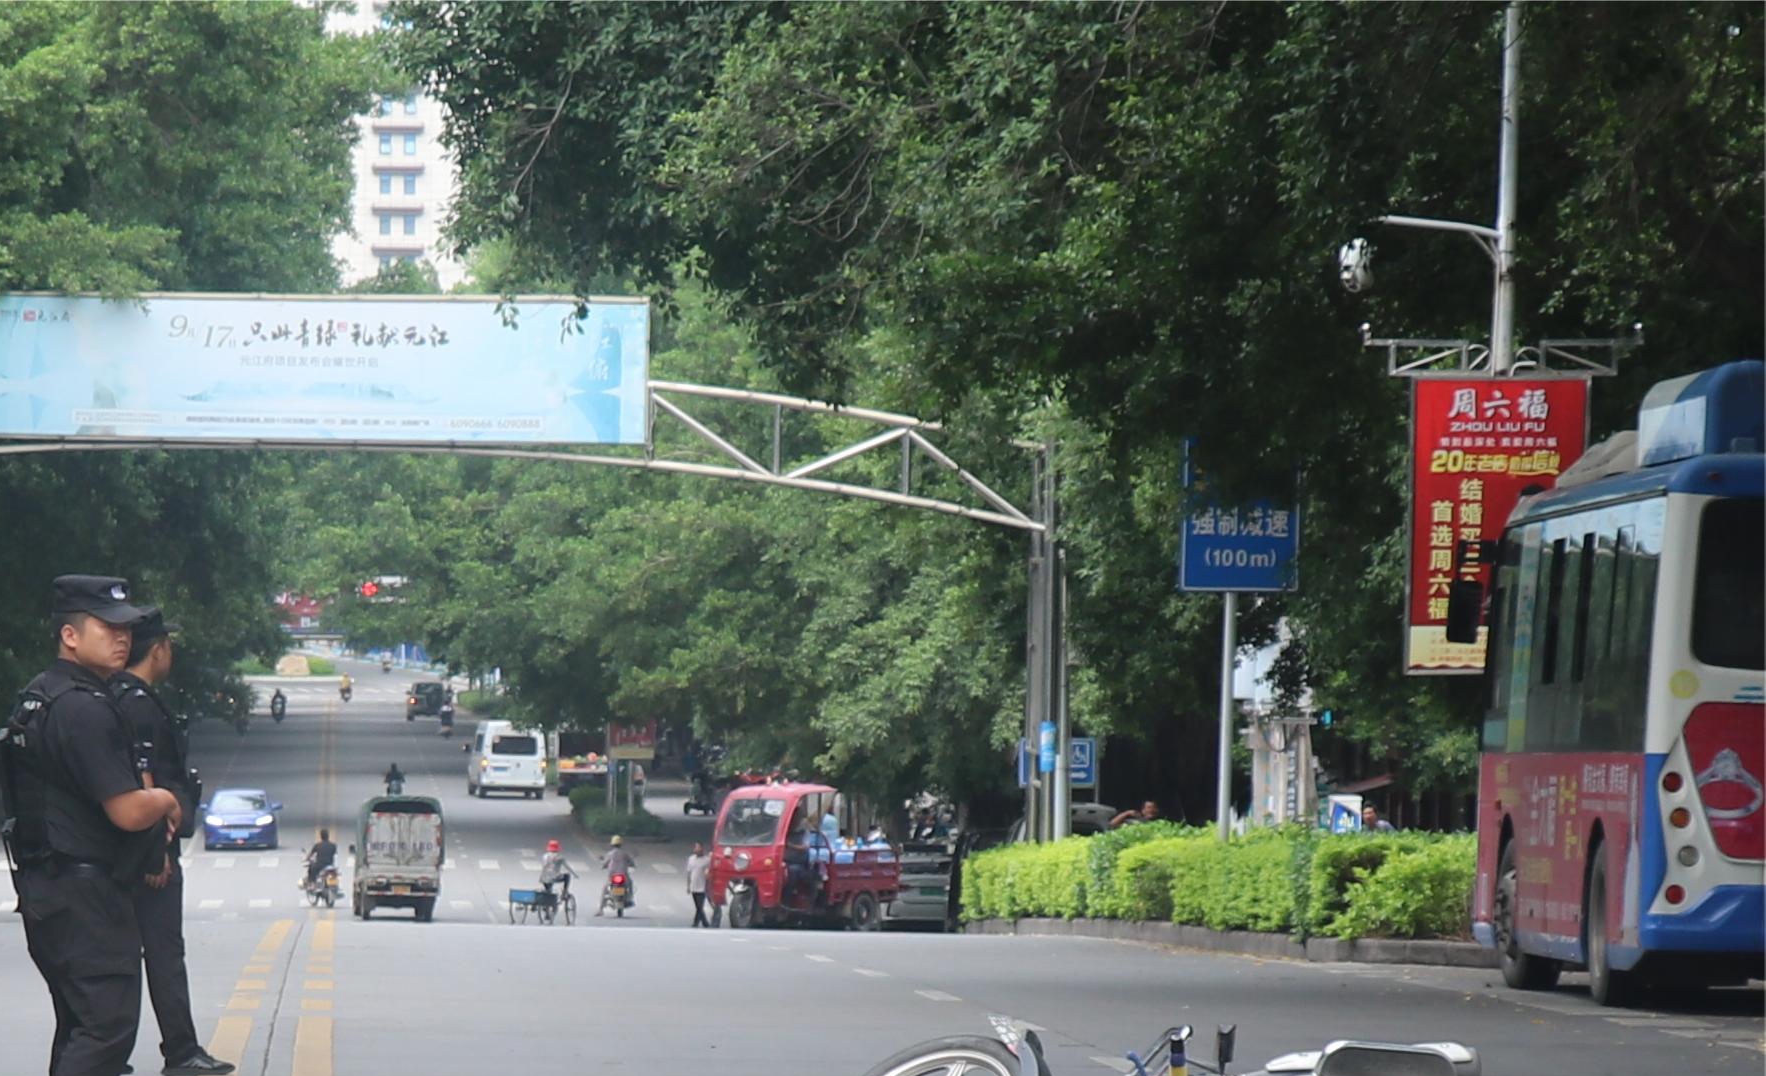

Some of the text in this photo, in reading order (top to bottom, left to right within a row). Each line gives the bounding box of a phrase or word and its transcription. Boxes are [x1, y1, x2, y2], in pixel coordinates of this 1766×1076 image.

[1448, 388, 1550, 420] 周六福
[1450, 421, 1546, 433] ZHOU LIU FU
[1428, 500, 1453, 621] 首选周六福
[1459, 478, 1483, 581] 结婚买三
